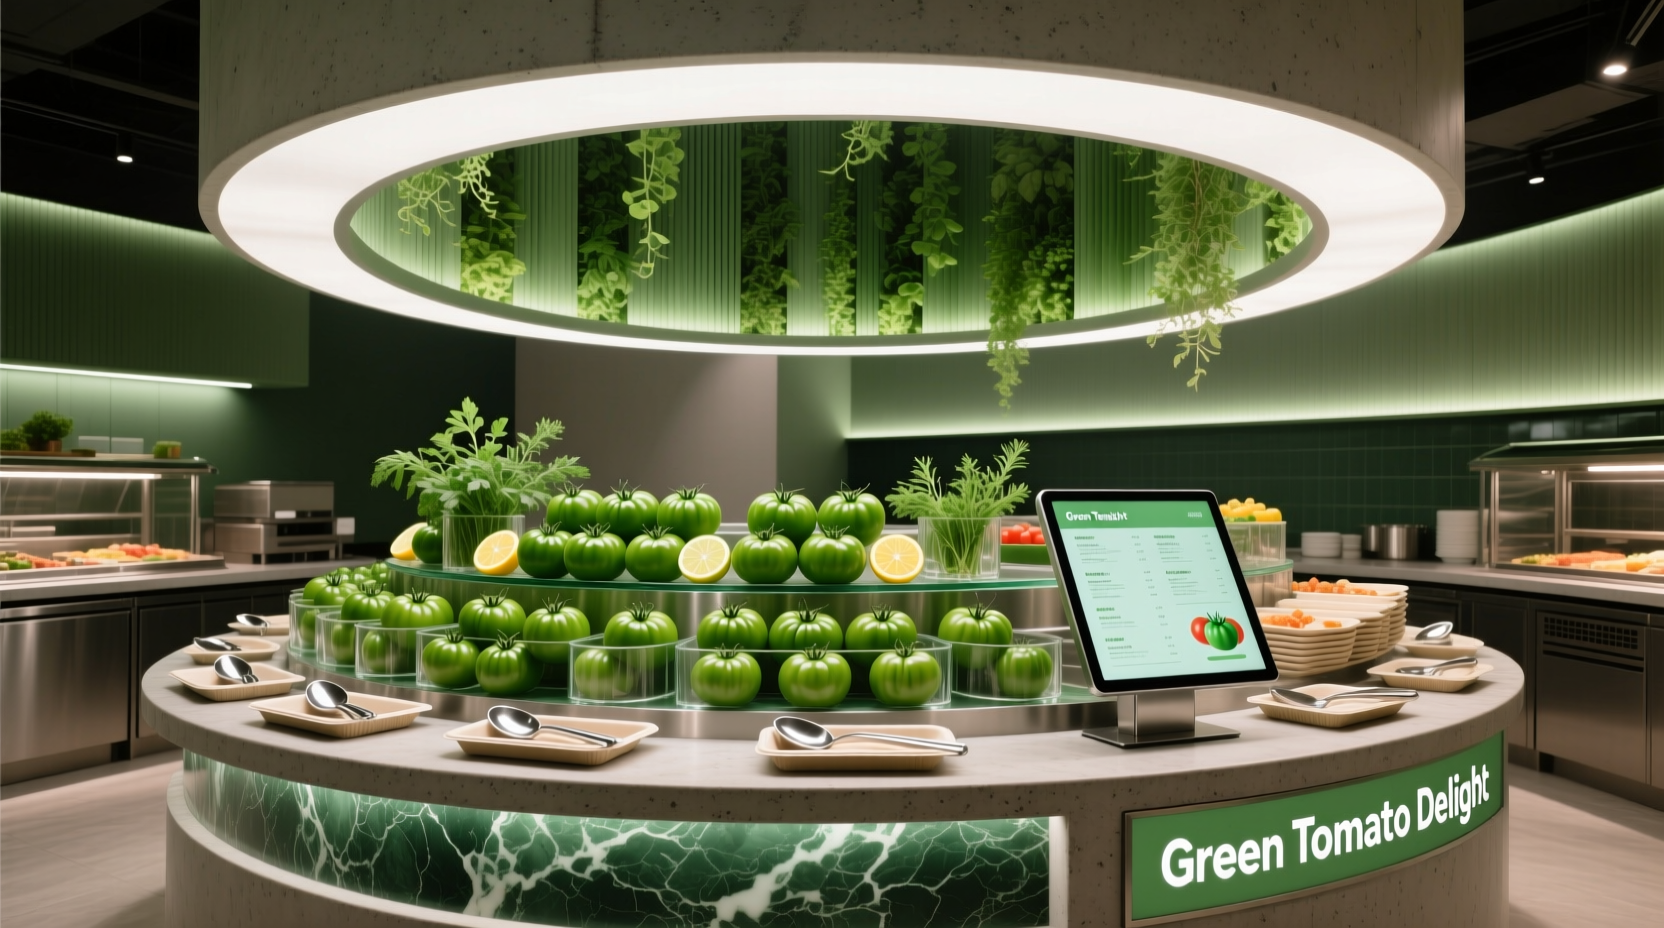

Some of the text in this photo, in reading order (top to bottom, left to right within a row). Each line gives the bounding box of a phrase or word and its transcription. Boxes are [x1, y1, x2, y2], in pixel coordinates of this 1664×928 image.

[1161, 763, 1490, 888] Green Tomato Delight
